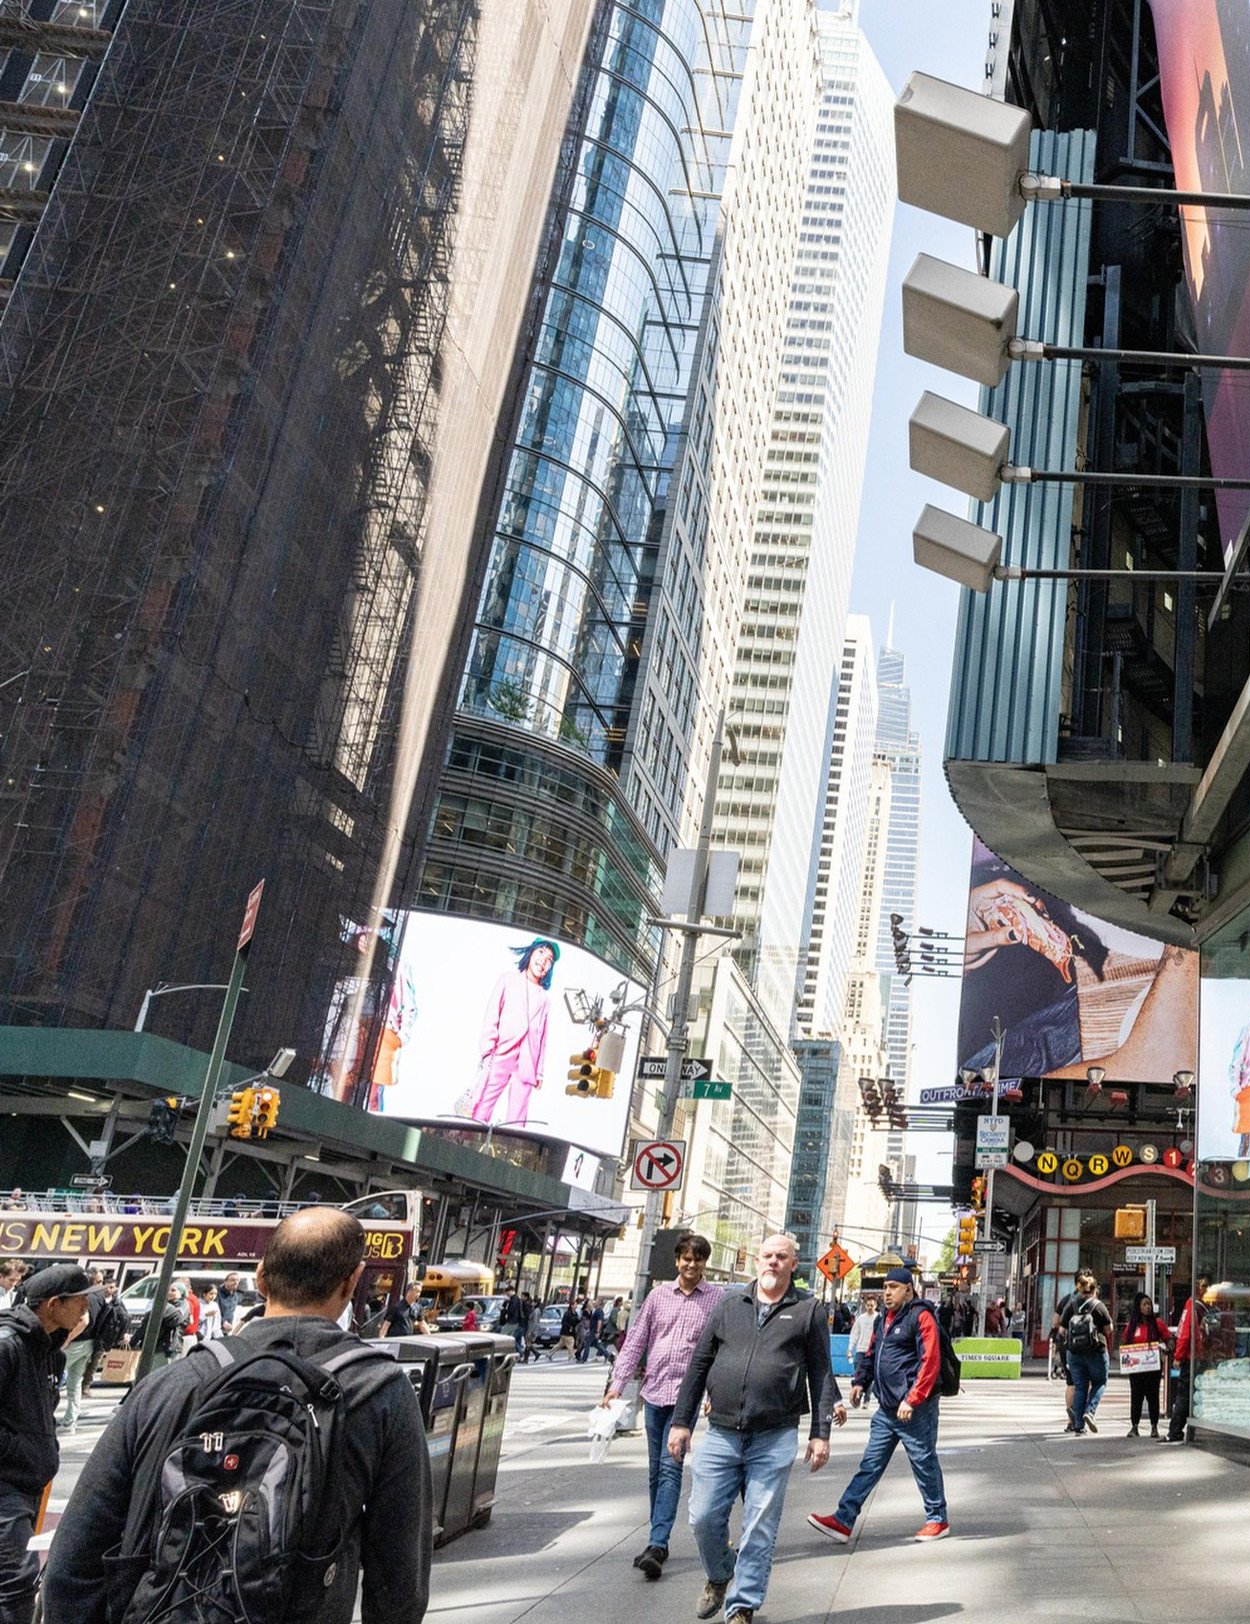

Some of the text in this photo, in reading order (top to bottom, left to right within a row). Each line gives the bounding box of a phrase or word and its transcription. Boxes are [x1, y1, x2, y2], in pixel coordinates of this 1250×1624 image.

[704, 1083, 710, 1097] 7
[1042, 1156, 1054, 1170] N
[1067, 1163, 1079, 1177] Q
[1093, 1158, 1104, 1171] R
[1115, 1150, 1130, 1164] W
[1143, 1147, 1155, 1160] S
[1169, 1151, 1176, 1165] 1
[1215, 1168, 1225, 1183] 3
[30, 1223, 123, 1252] NEW
[133, 1226, 228, 1255] YORK
[365, 1232, 383, 1246] IG
